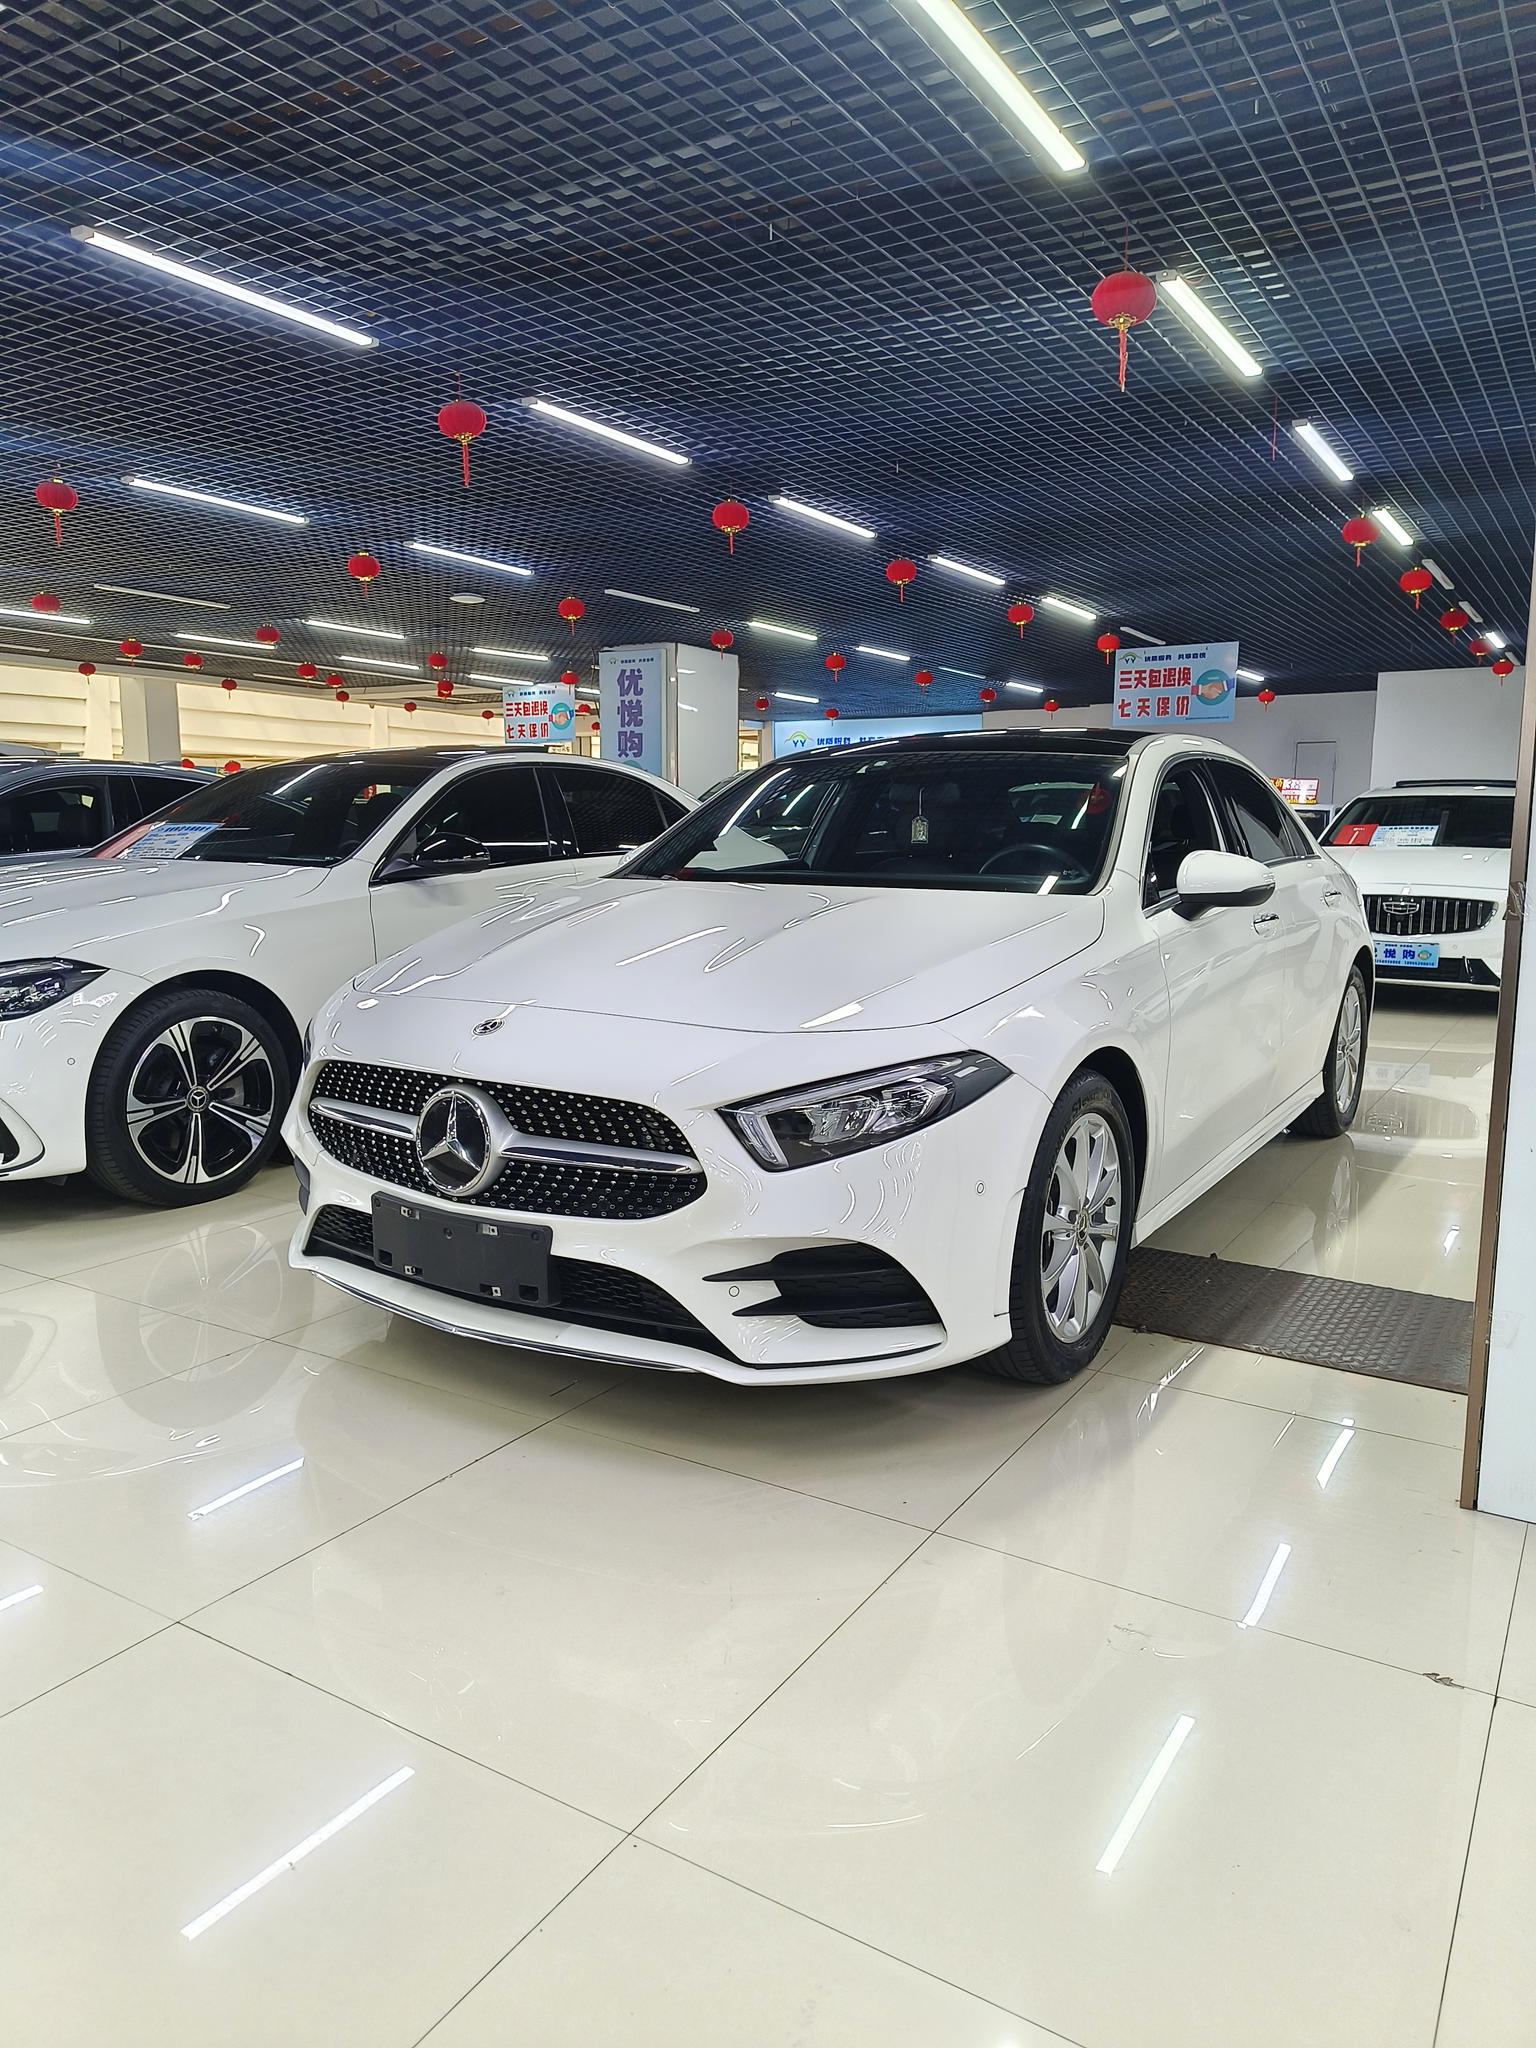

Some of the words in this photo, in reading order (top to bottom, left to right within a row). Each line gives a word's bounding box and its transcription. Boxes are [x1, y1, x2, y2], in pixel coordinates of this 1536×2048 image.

[1119, 667, 1191, 690] 三天包退换
[505, 700, 549, 717] 三天包退换
[617, 668, 644, 759] 优悦购
[1118, 696, 1190, 718] 七天保价
[506, 722, 549, 739] 七天保价
[793, 740, 807, 748] YY
[1374, 947, 1416, 960] 悦购
